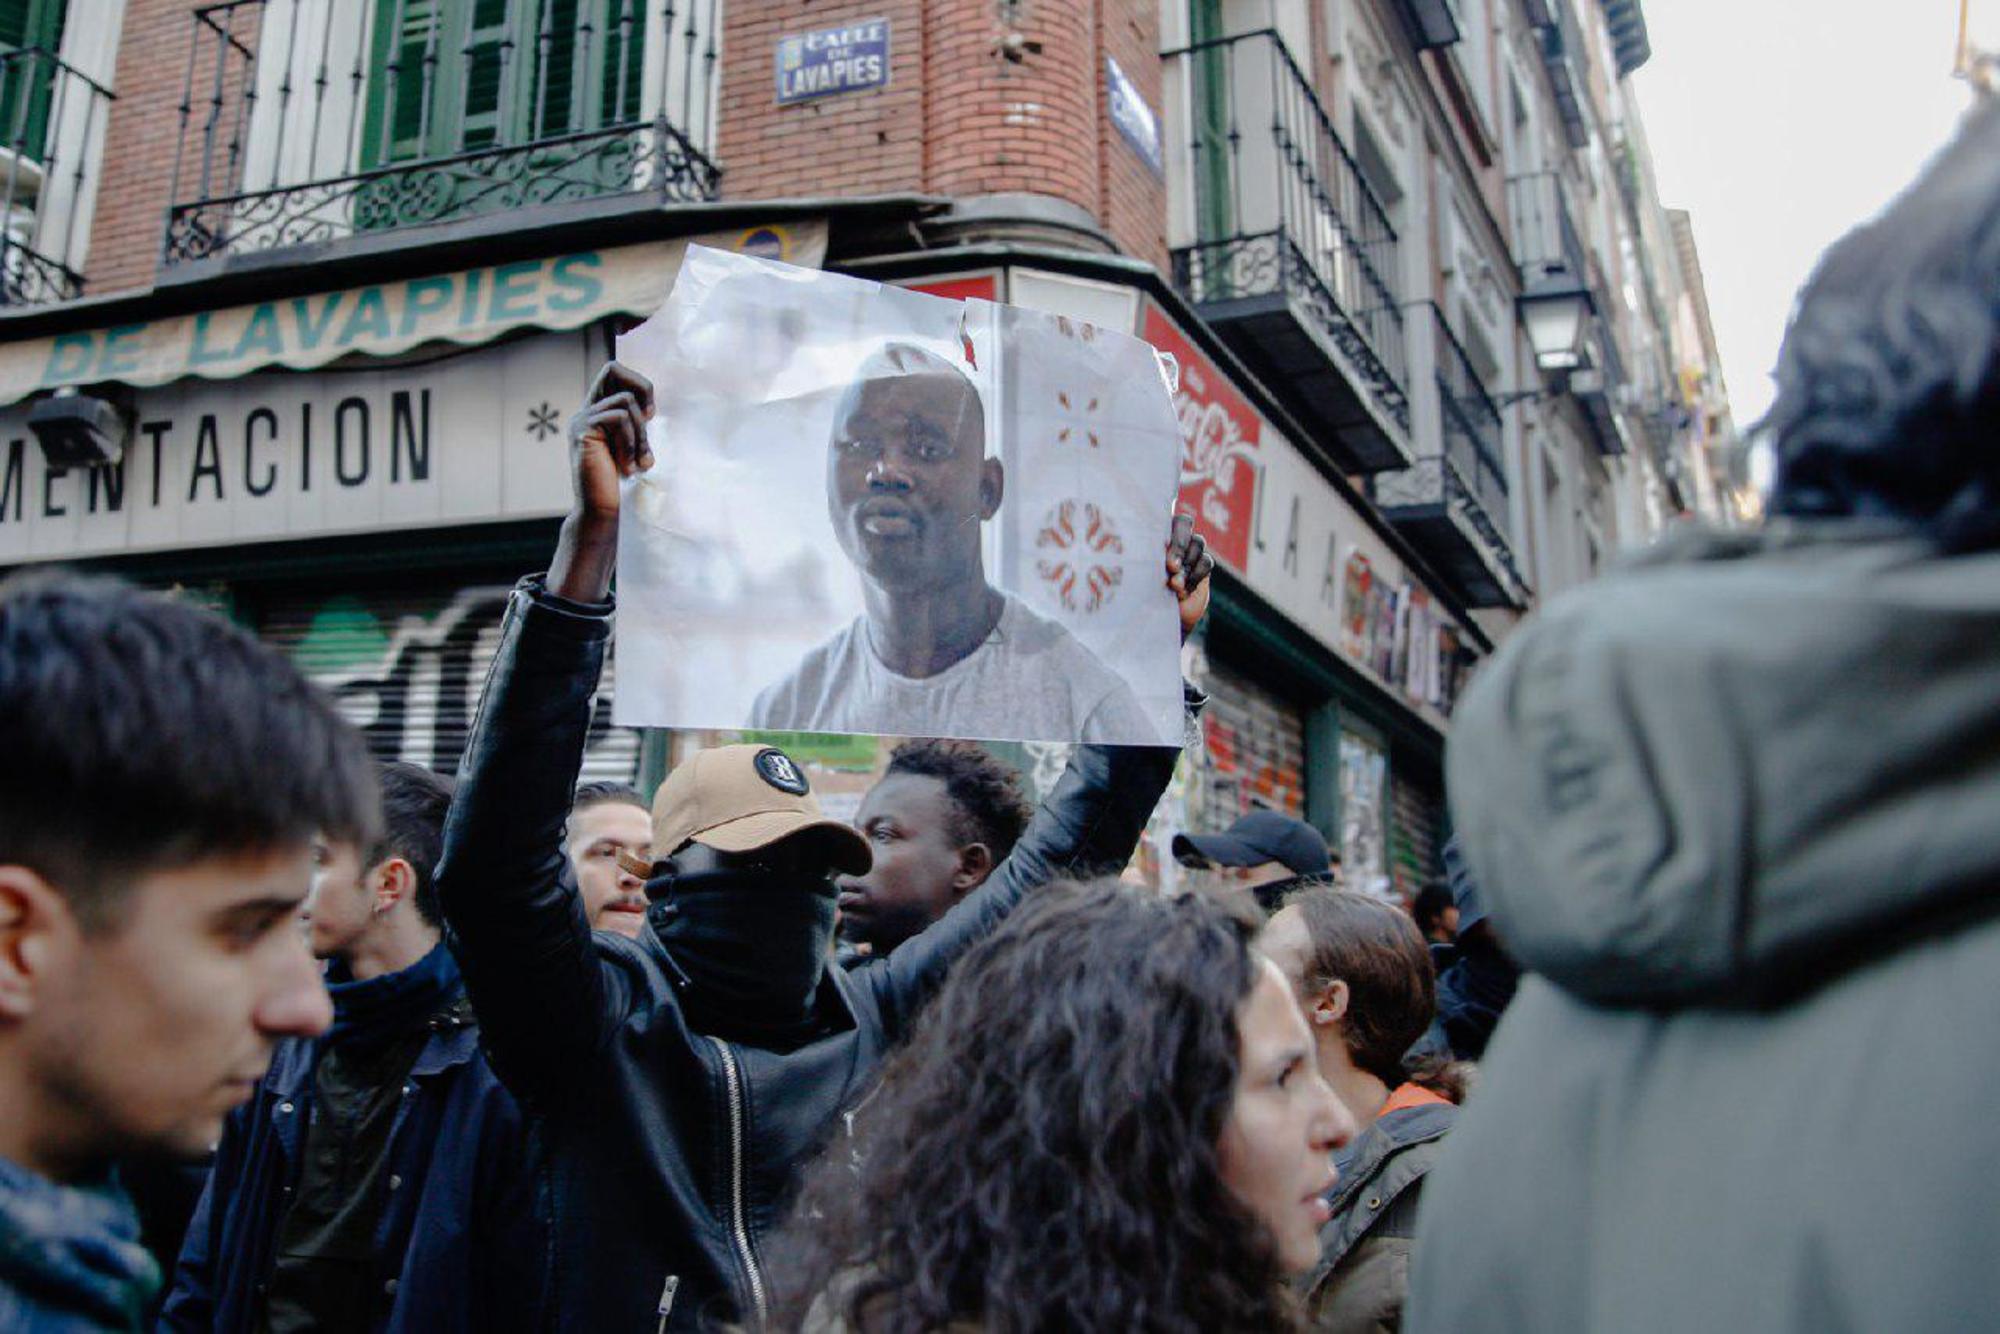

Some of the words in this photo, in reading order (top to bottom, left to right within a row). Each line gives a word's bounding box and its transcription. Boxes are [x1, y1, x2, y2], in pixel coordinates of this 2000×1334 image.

[804, 25, 882, 50] CALLE
[783, 55, 881, 97] LAVAPIES
[41, 323, 149, 386] DE
[187, 252, 603, 367] LAVAPIES
